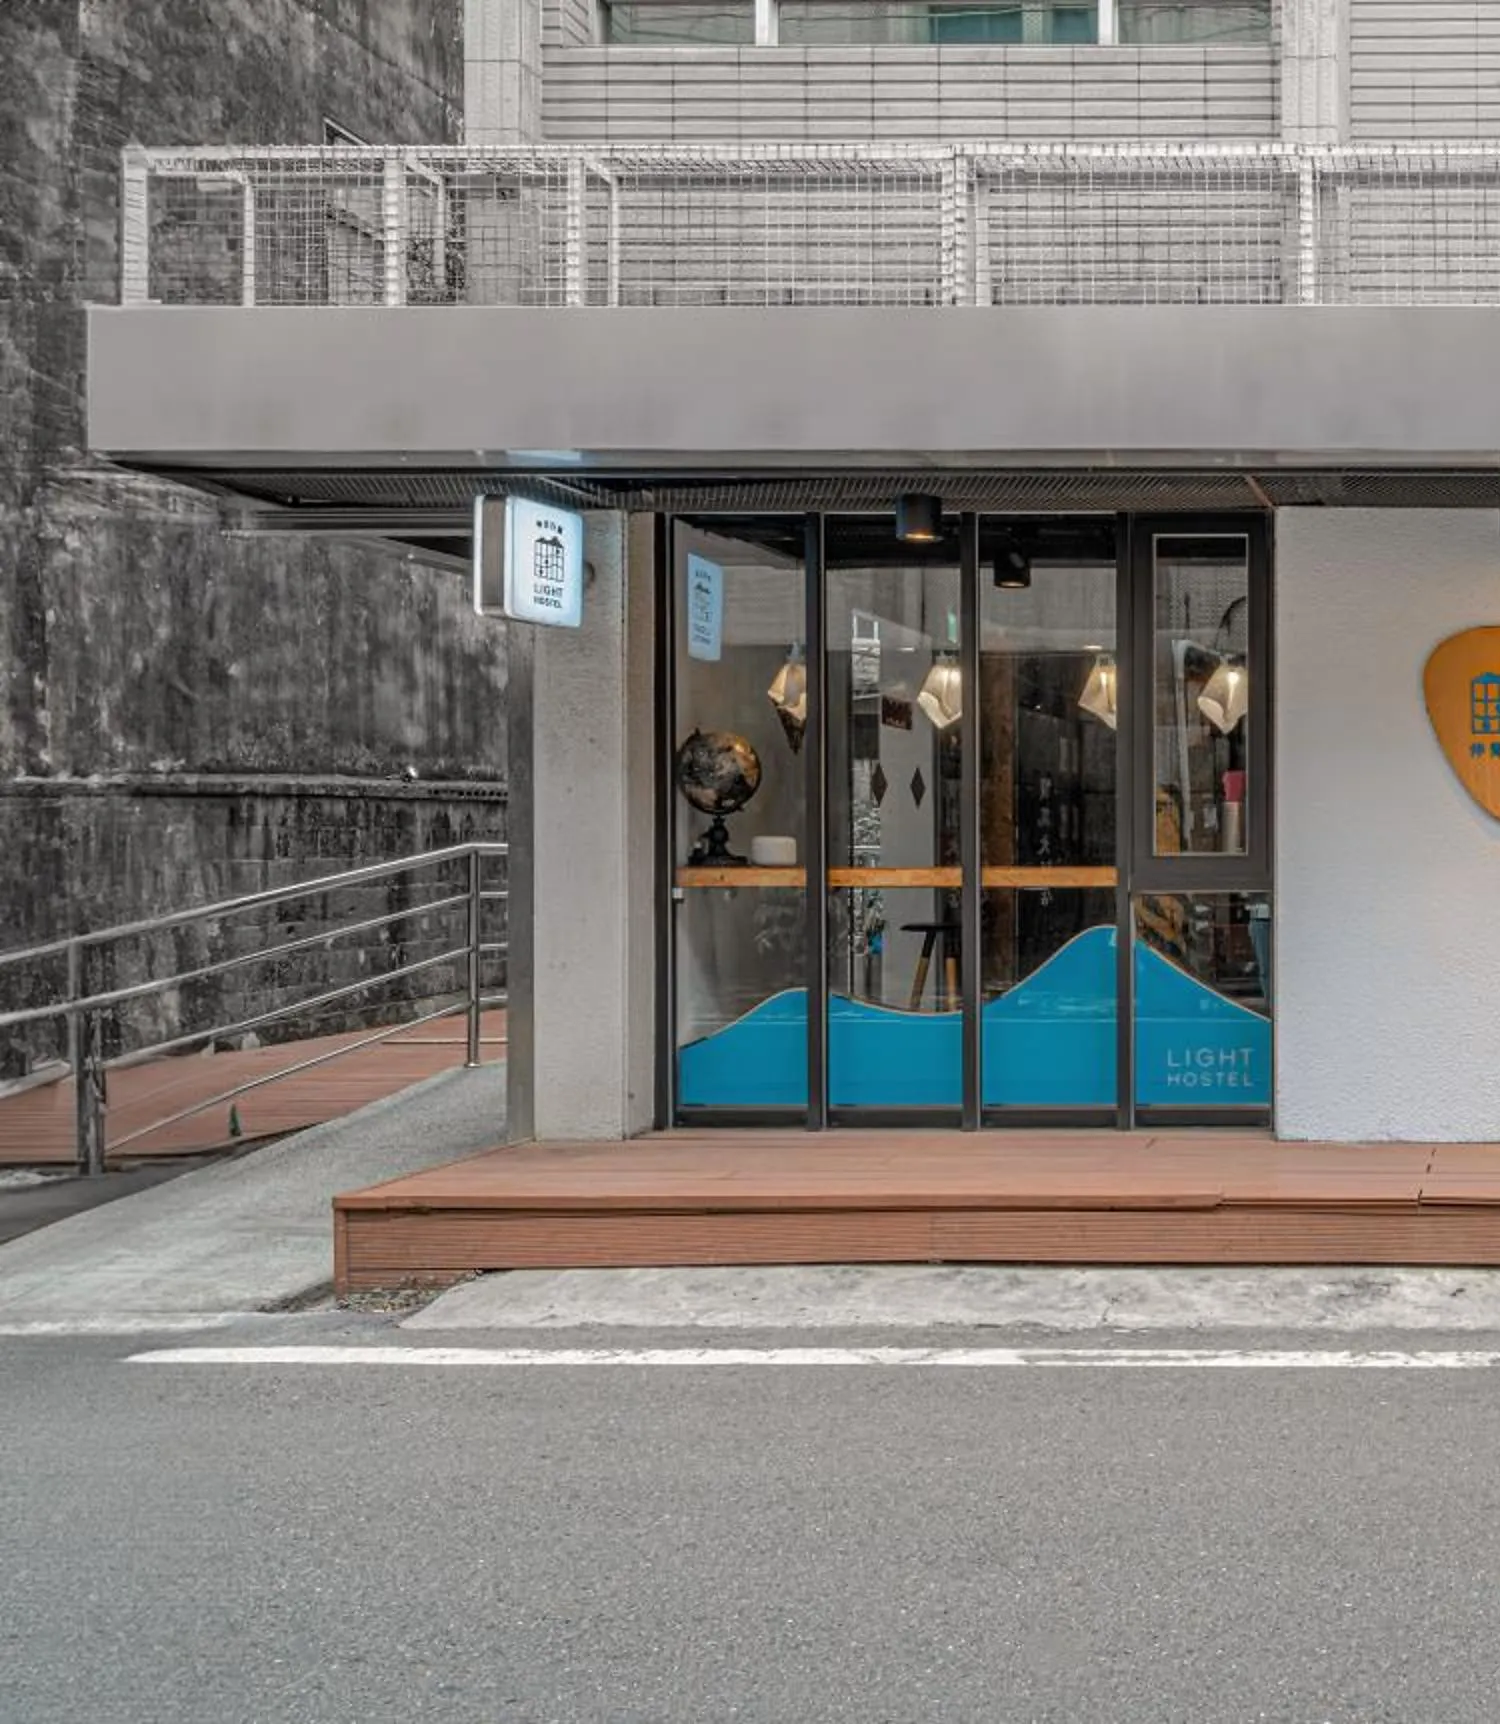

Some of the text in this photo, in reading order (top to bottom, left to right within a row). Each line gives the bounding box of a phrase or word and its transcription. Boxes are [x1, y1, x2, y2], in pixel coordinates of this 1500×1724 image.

[534, 583, 563, 598] LIGHT
[1167, 1047, 1255, 1068] LIGHT
[1166, 1071, 1254, 1088] HOSTEL
